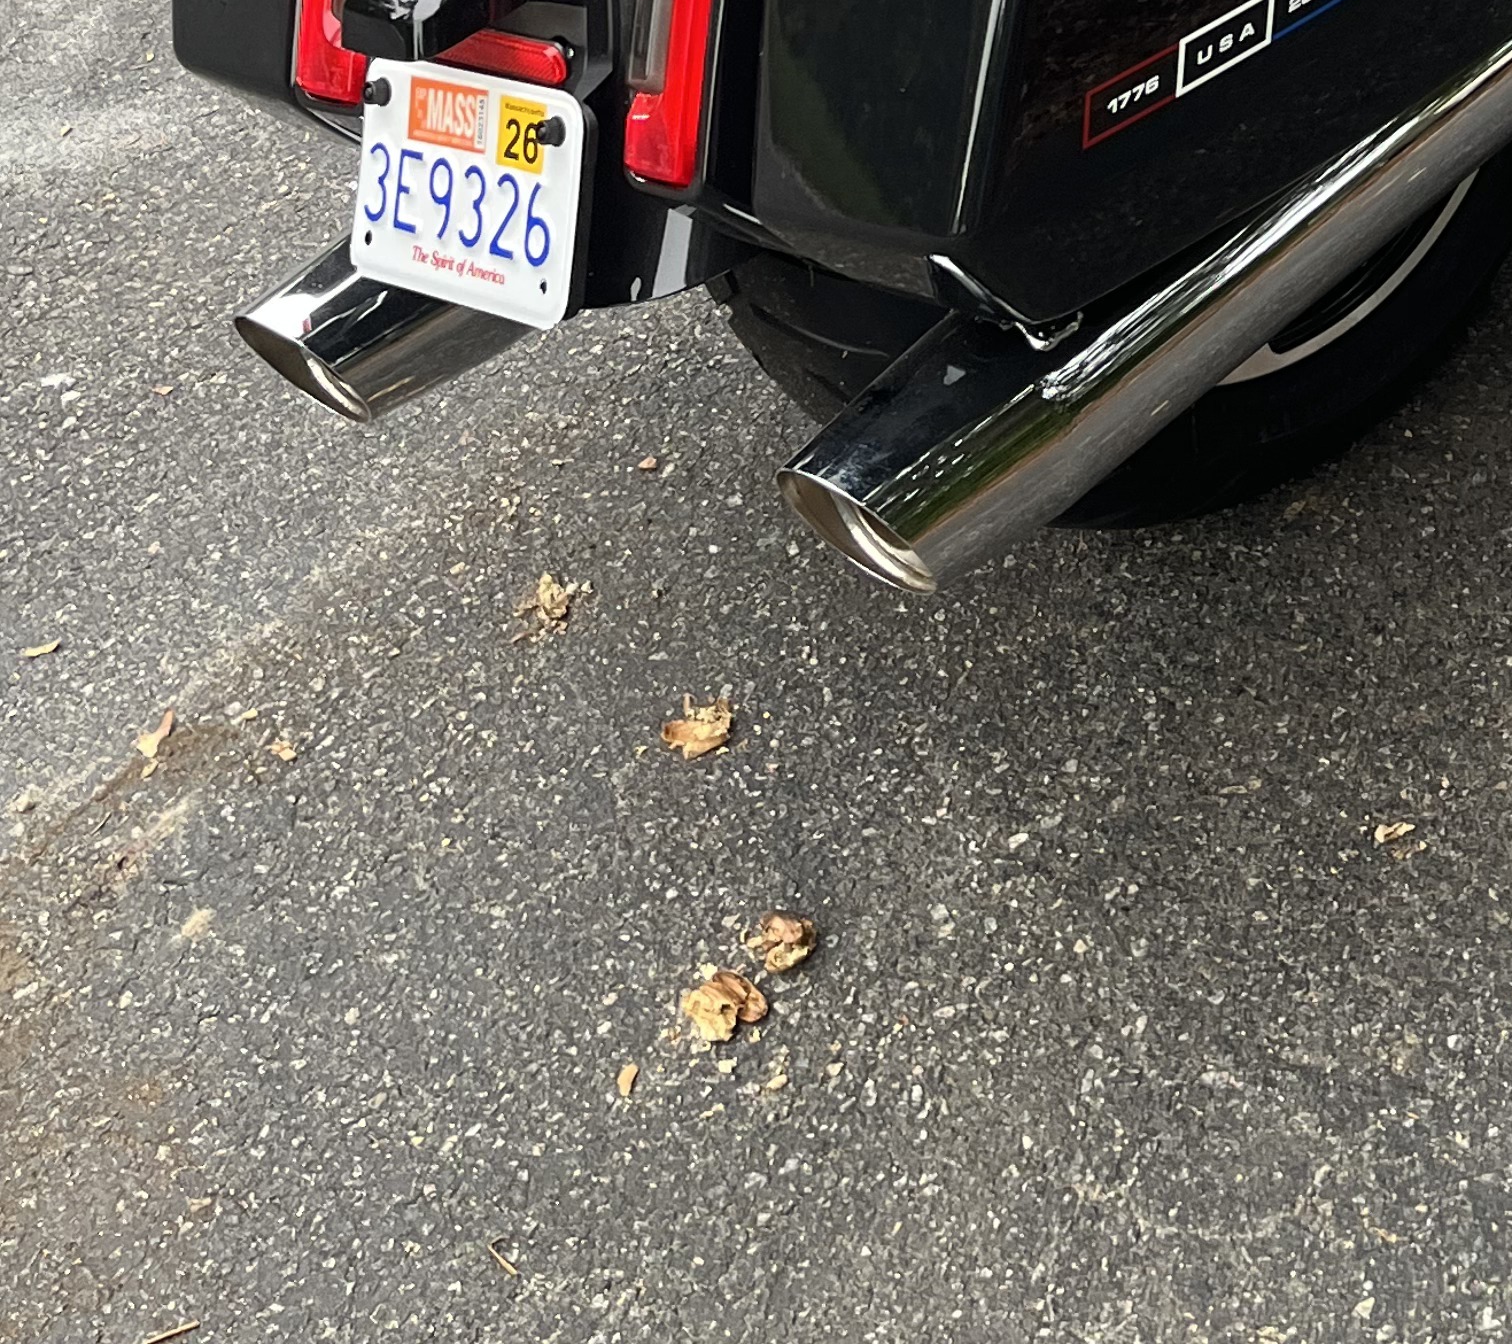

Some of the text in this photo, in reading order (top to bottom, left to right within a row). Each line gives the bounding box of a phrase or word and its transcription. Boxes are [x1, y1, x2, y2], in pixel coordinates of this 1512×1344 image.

[1107, 75, 1160, 114] 1776
[1197, 22, 1256, 65] USA
[426, 87, 476, 139] MASS
[504, 118, 539, 164] 26
[364, 142, 550, 267] 3E9326
[412, 245, 505, 285] The Spirit of America
